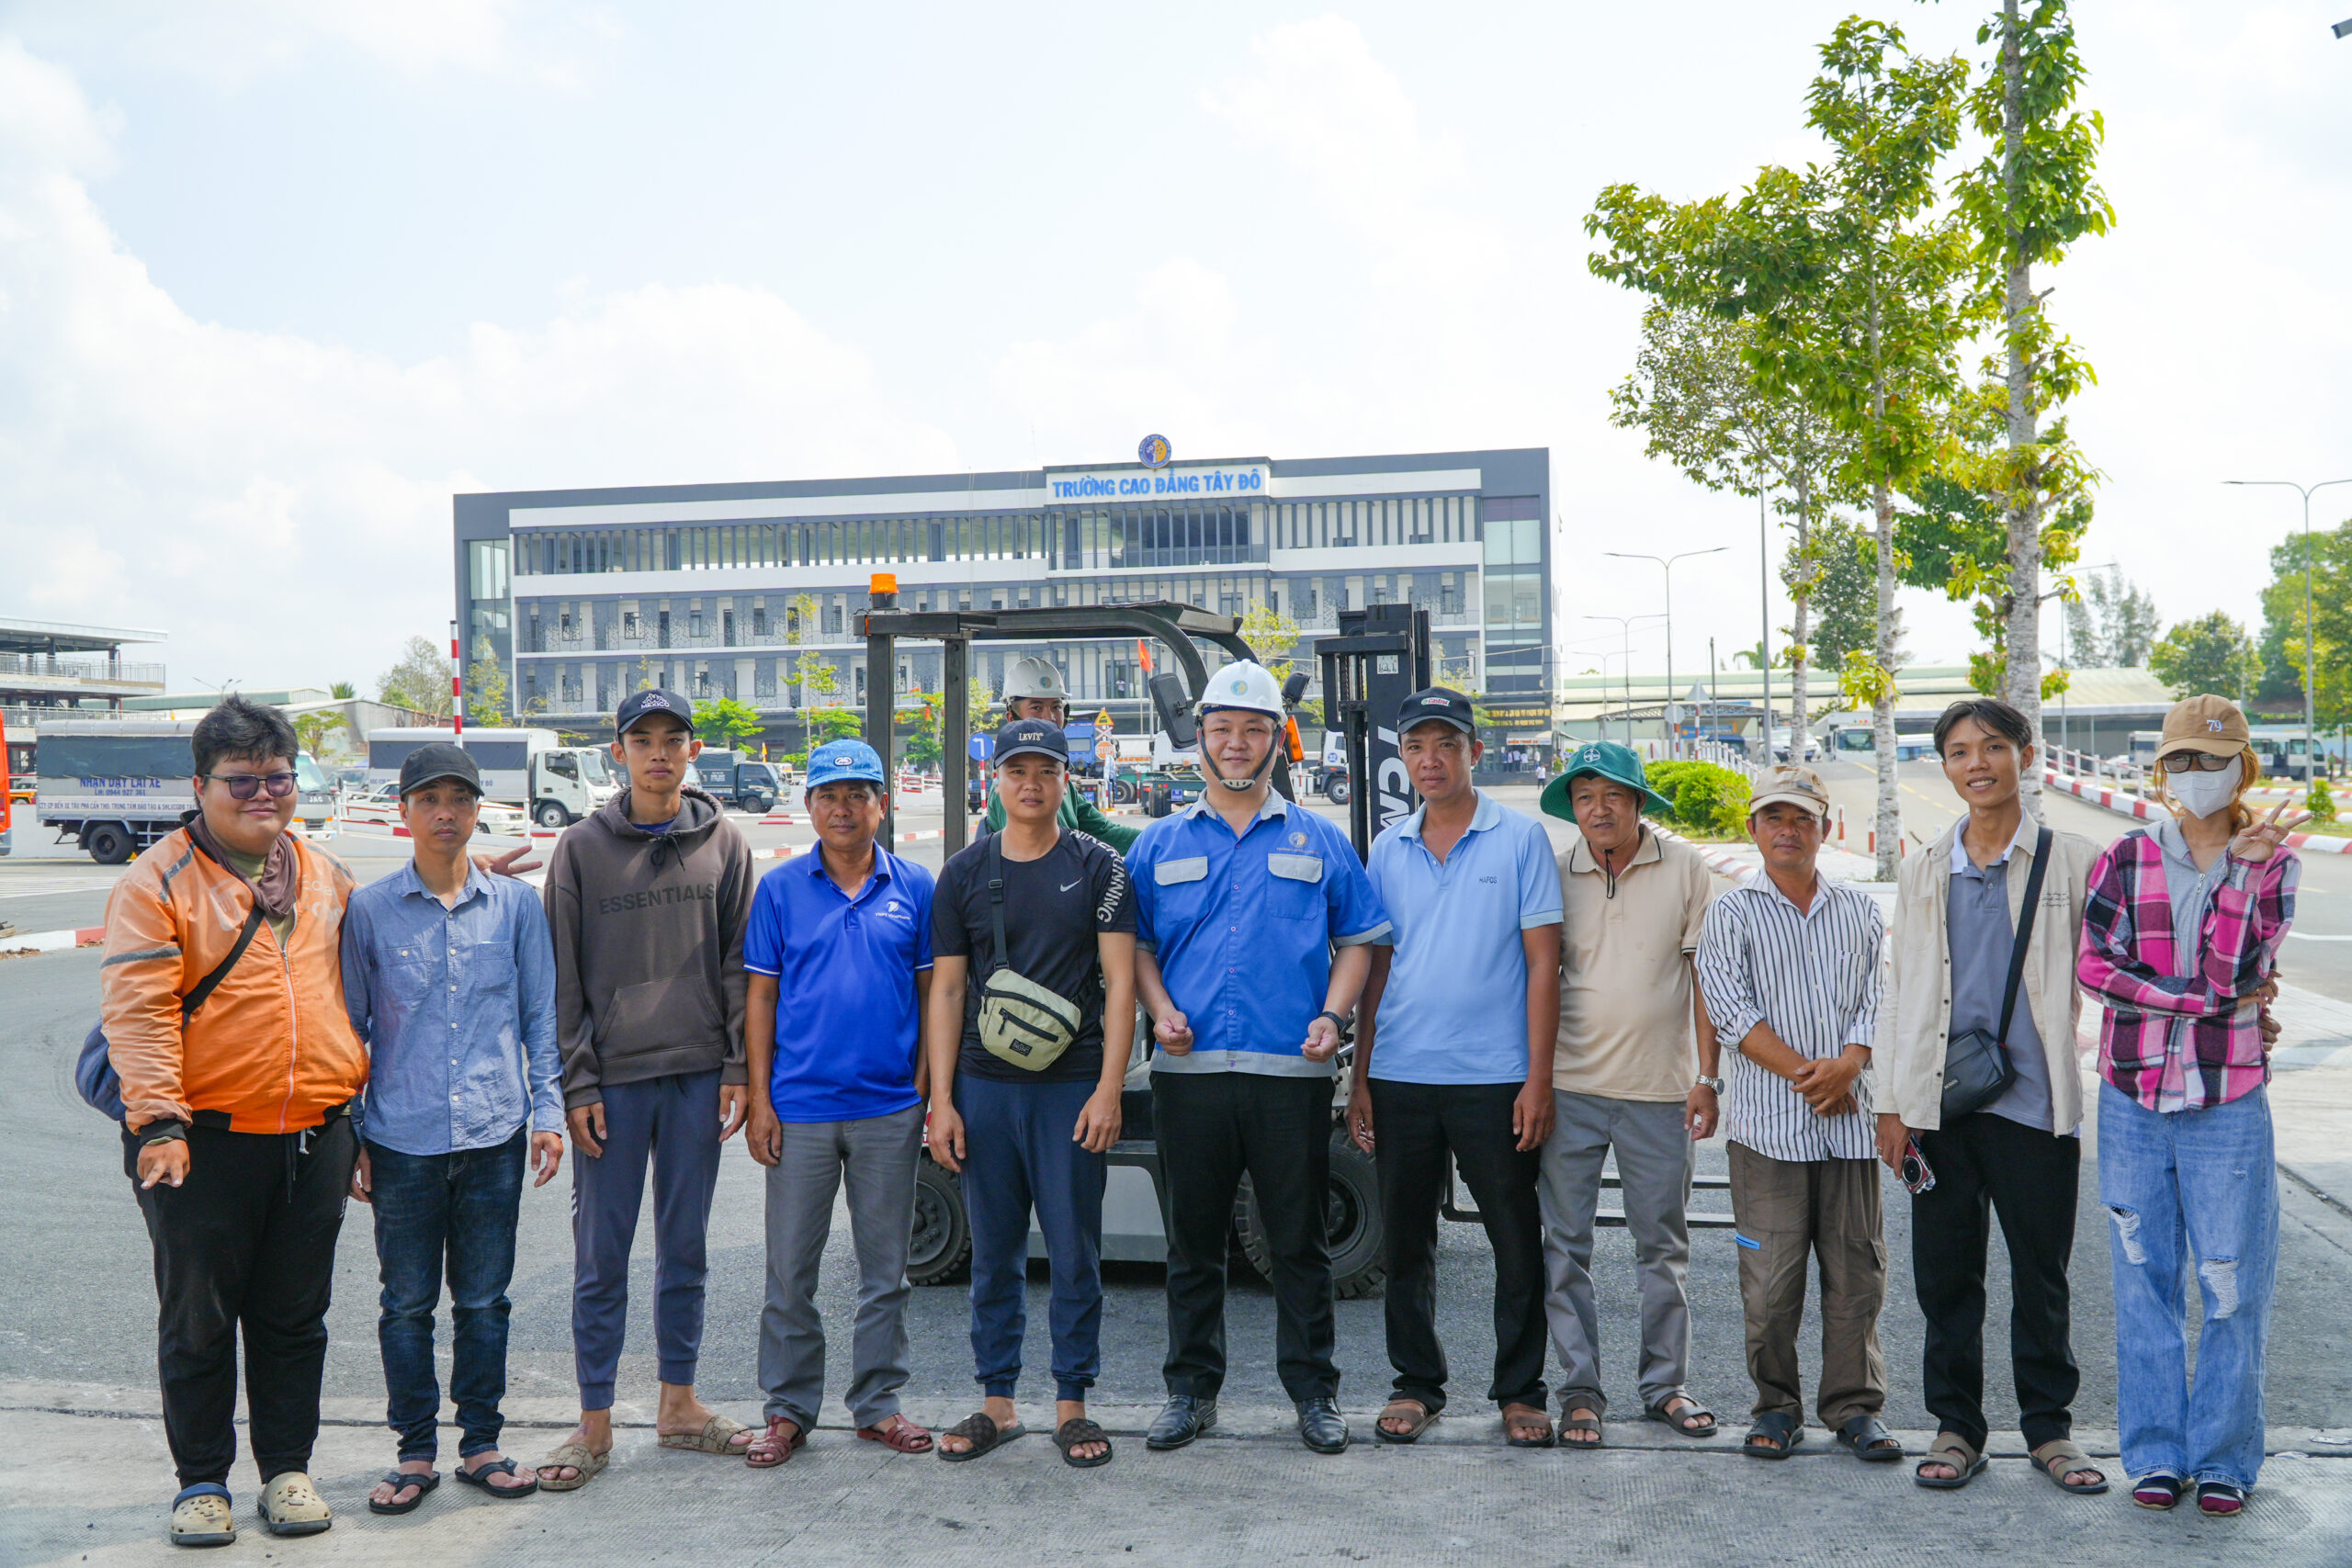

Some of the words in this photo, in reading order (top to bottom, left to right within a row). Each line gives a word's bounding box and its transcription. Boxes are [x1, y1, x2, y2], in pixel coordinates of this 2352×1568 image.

[1052, 475, 1116, 498] TRƯỜNG
[1119, 478, 1151, 495] CAO
[1155, 468, 1200, 493] ĐẲNG
[1203, 470, 1234, 491] TÂY
[1238, 468, 1261, 490] ĐÔ
[640, 700, 670, 709] MEXICO
[1428, 697, 1449, 705] Castrol
[2206, 719, 2222, 732] 79
[598, 883, 715, 915] ESSENTIALS
